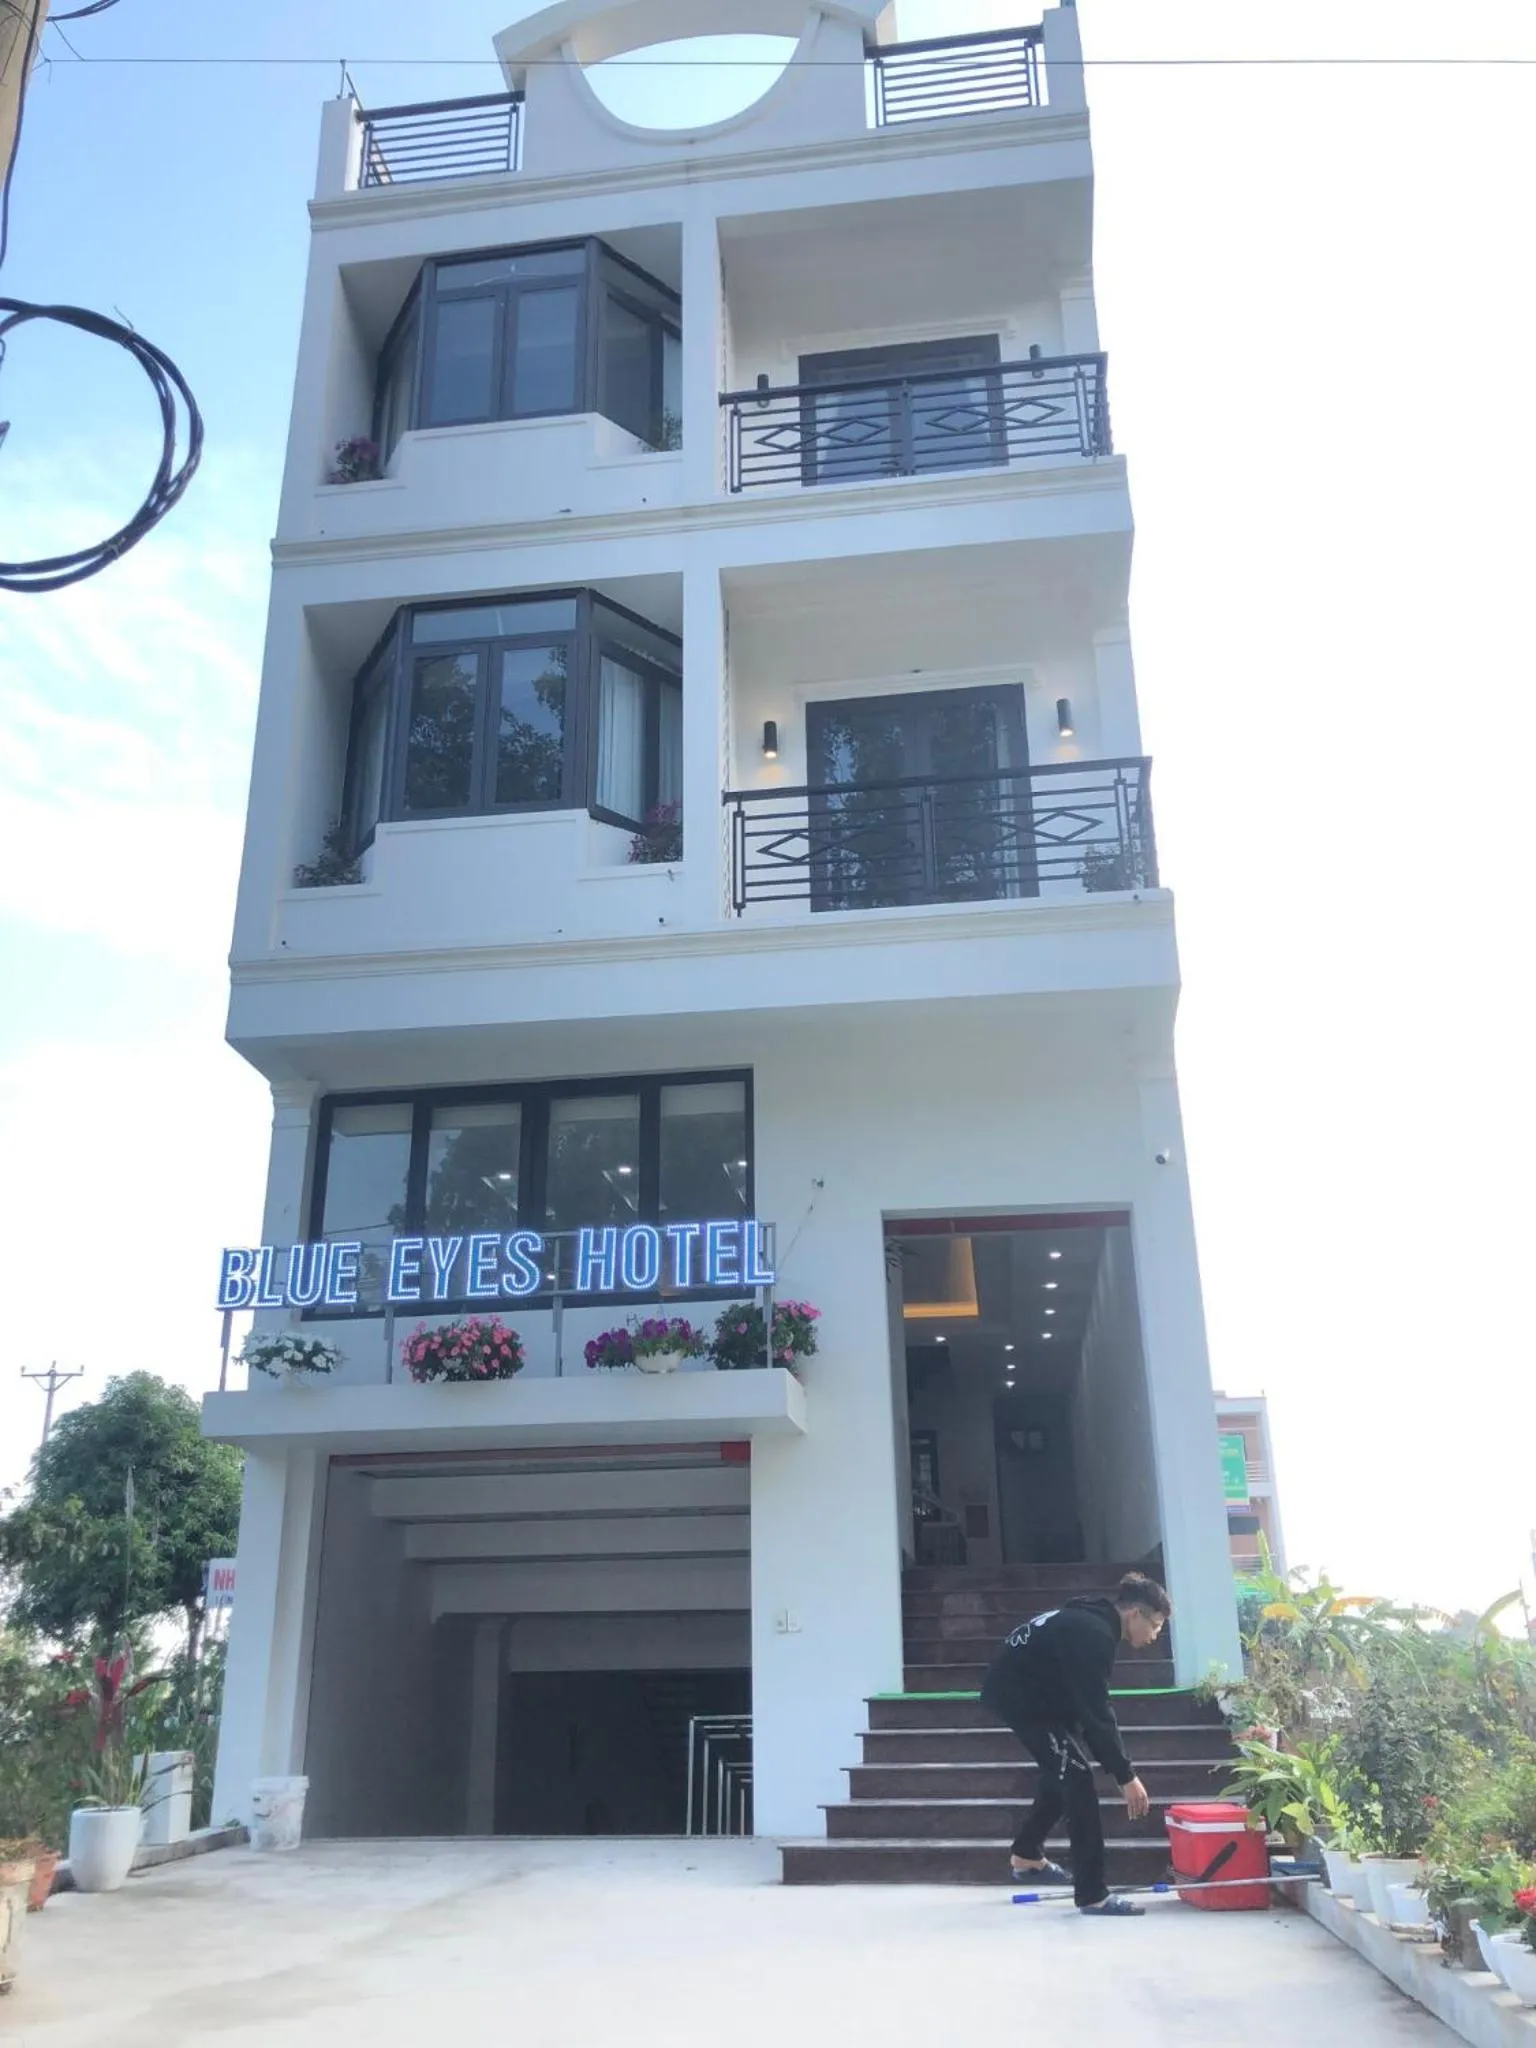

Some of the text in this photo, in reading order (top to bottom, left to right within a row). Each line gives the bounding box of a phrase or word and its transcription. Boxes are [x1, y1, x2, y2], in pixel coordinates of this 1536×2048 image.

[217, 1220, 775, 1308] BLUE EYES HOTEL
